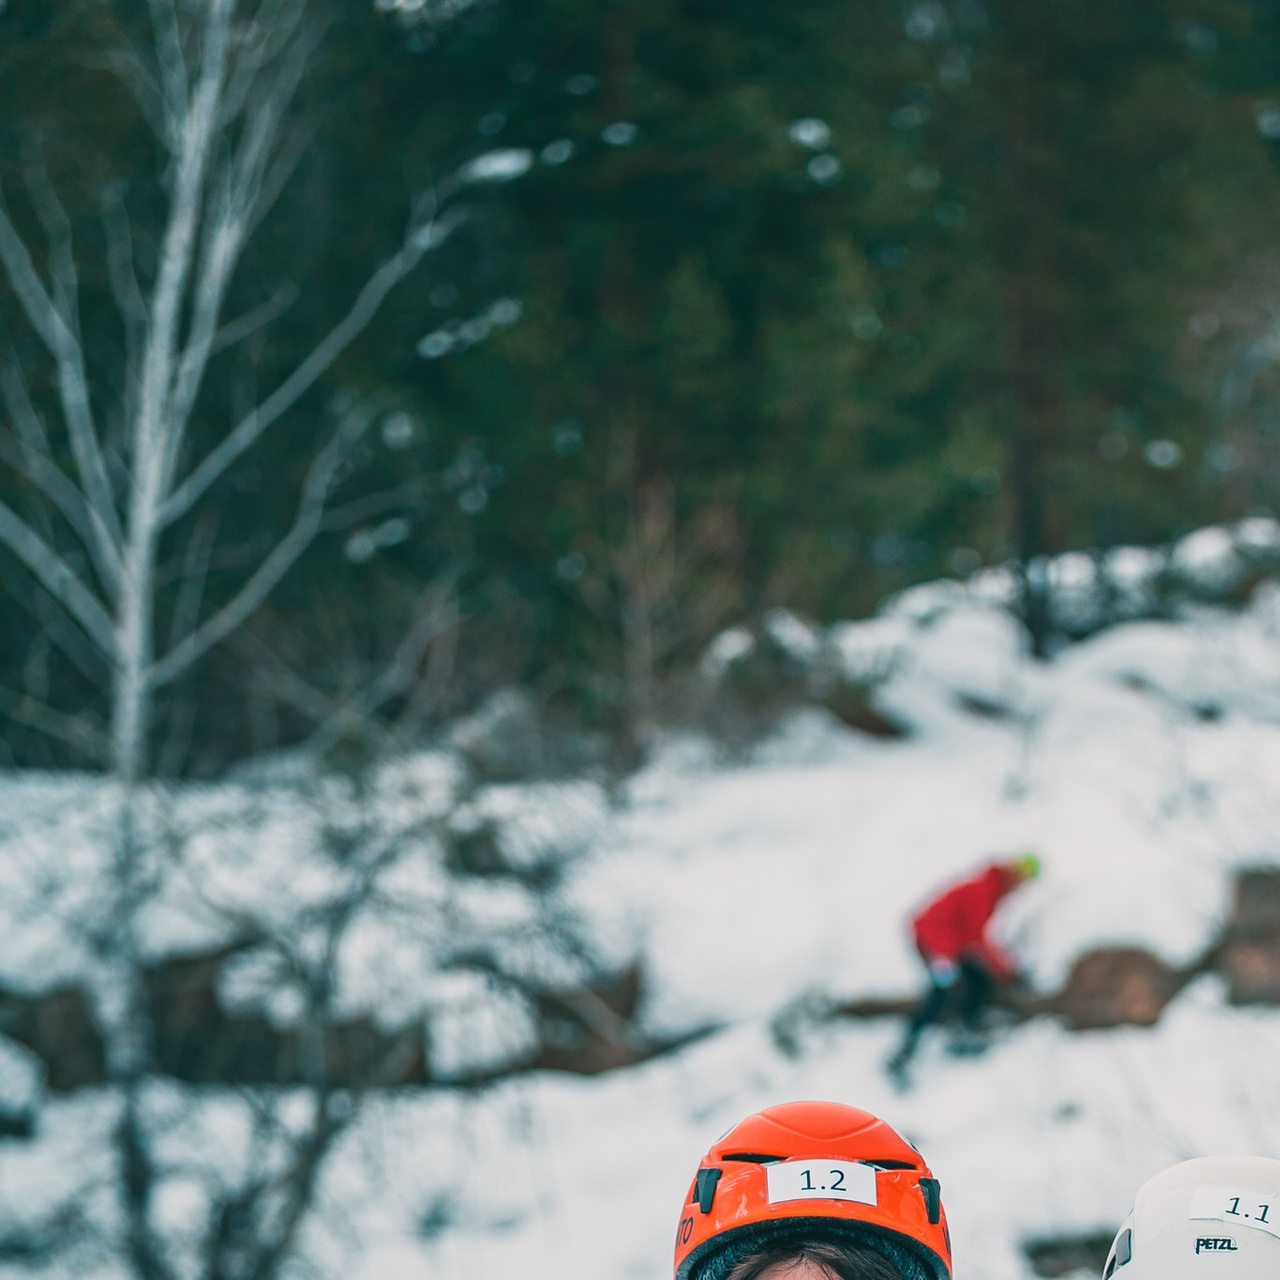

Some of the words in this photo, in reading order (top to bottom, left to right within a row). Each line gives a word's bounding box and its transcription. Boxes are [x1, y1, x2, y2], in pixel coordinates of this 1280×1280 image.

[799, 1169, 847, 1191] 1.2
[1225, 1197, 1270, 1224] 1.1
[1195, 1238, 1239, 1255] PETZL
